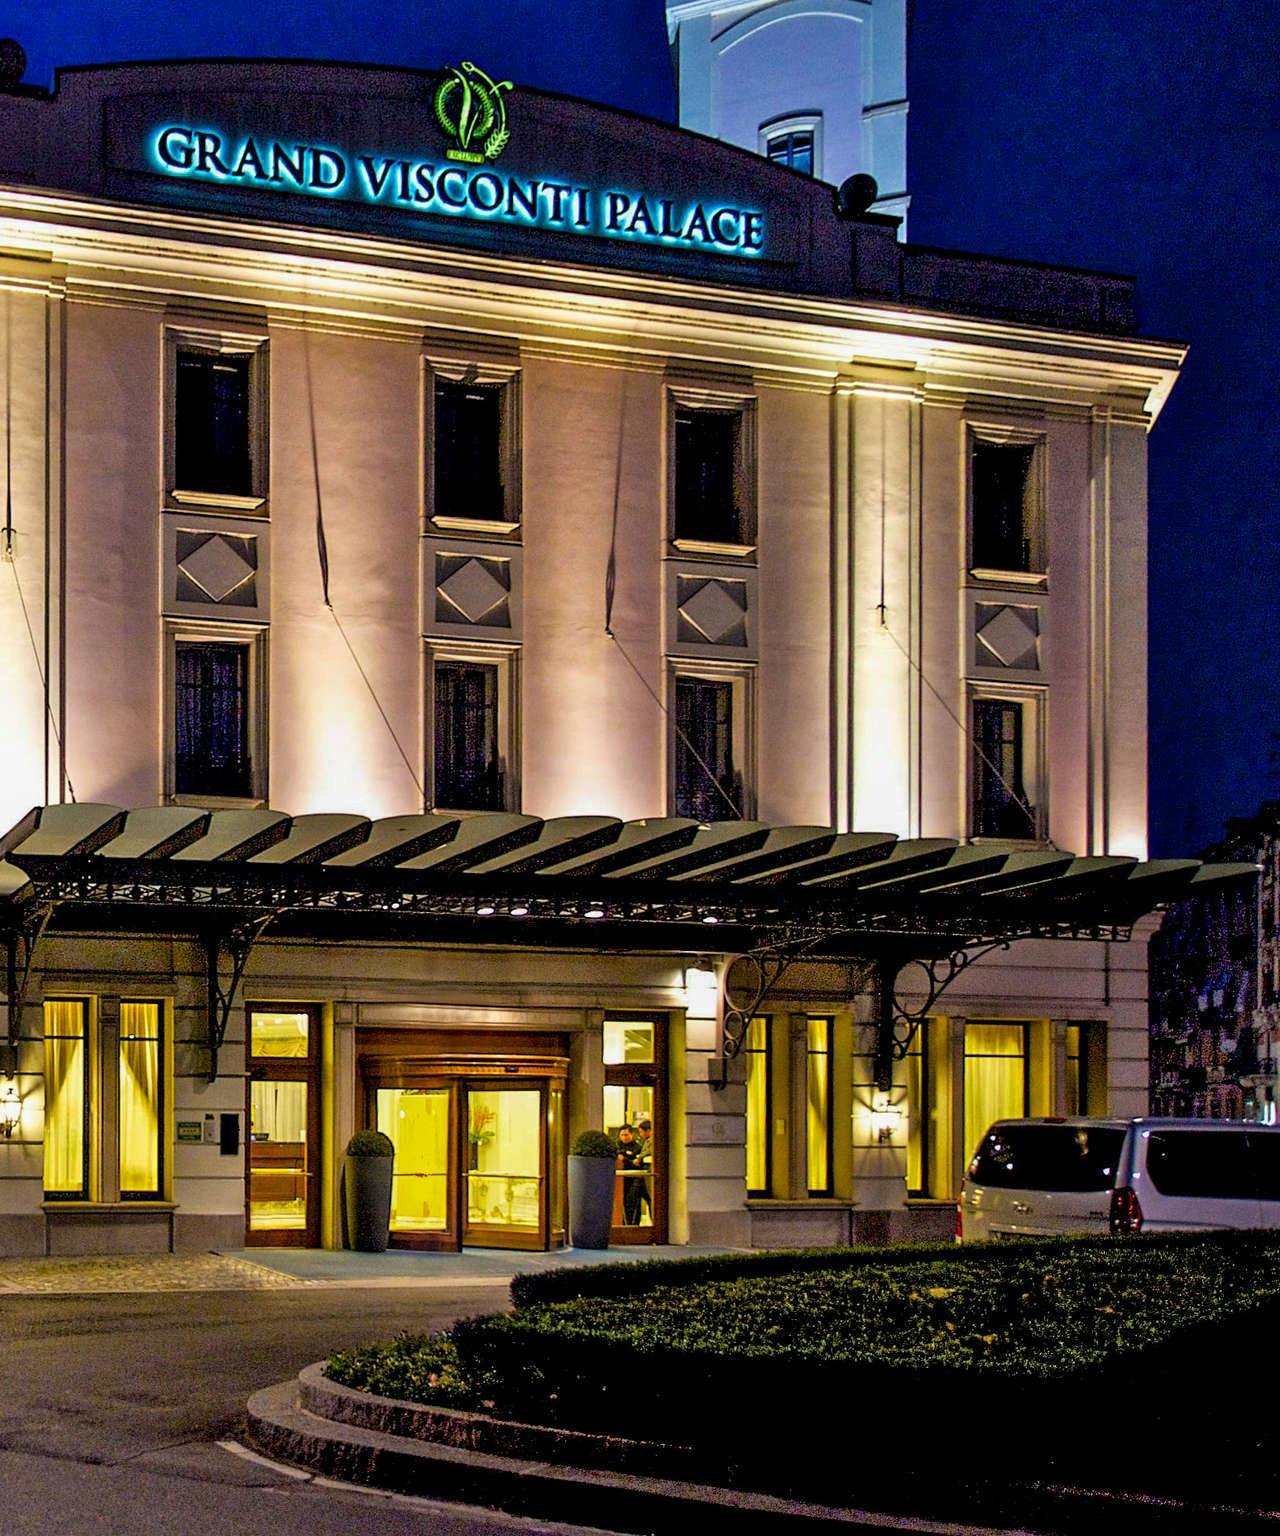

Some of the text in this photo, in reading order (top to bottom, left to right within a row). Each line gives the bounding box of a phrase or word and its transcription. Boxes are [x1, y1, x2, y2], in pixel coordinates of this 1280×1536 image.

[158, 127, 764, 250] GRAND VISCONTI PALACE
